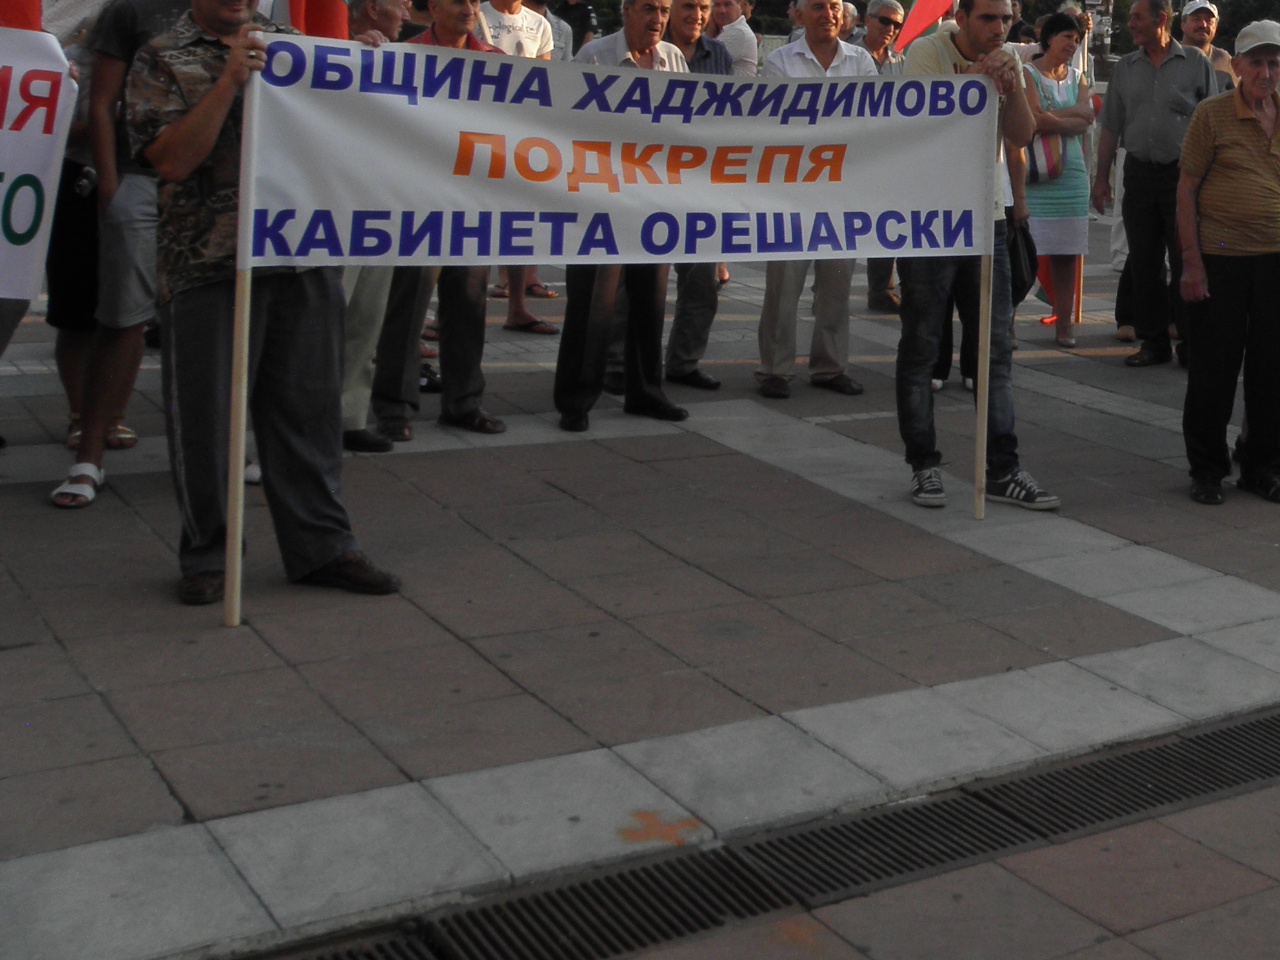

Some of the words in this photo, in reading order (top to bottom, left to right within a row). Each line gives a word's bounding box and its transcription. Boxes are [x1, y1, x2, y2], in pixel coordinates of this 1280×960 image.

[0, 66, 63, 135] Я
[261, 41, 552, 107] ОБЩИНА
[572, 72, 987, 125] ХАДЖИДИМОВО
[453, 131, 847, 193] ПОДКРЕПЯ
[0, 173, 45, 246] О
[252, 208, 619, 257] КАБИНЕТА
[640, 210, 973, 255] ОРЕШАРСКИ
